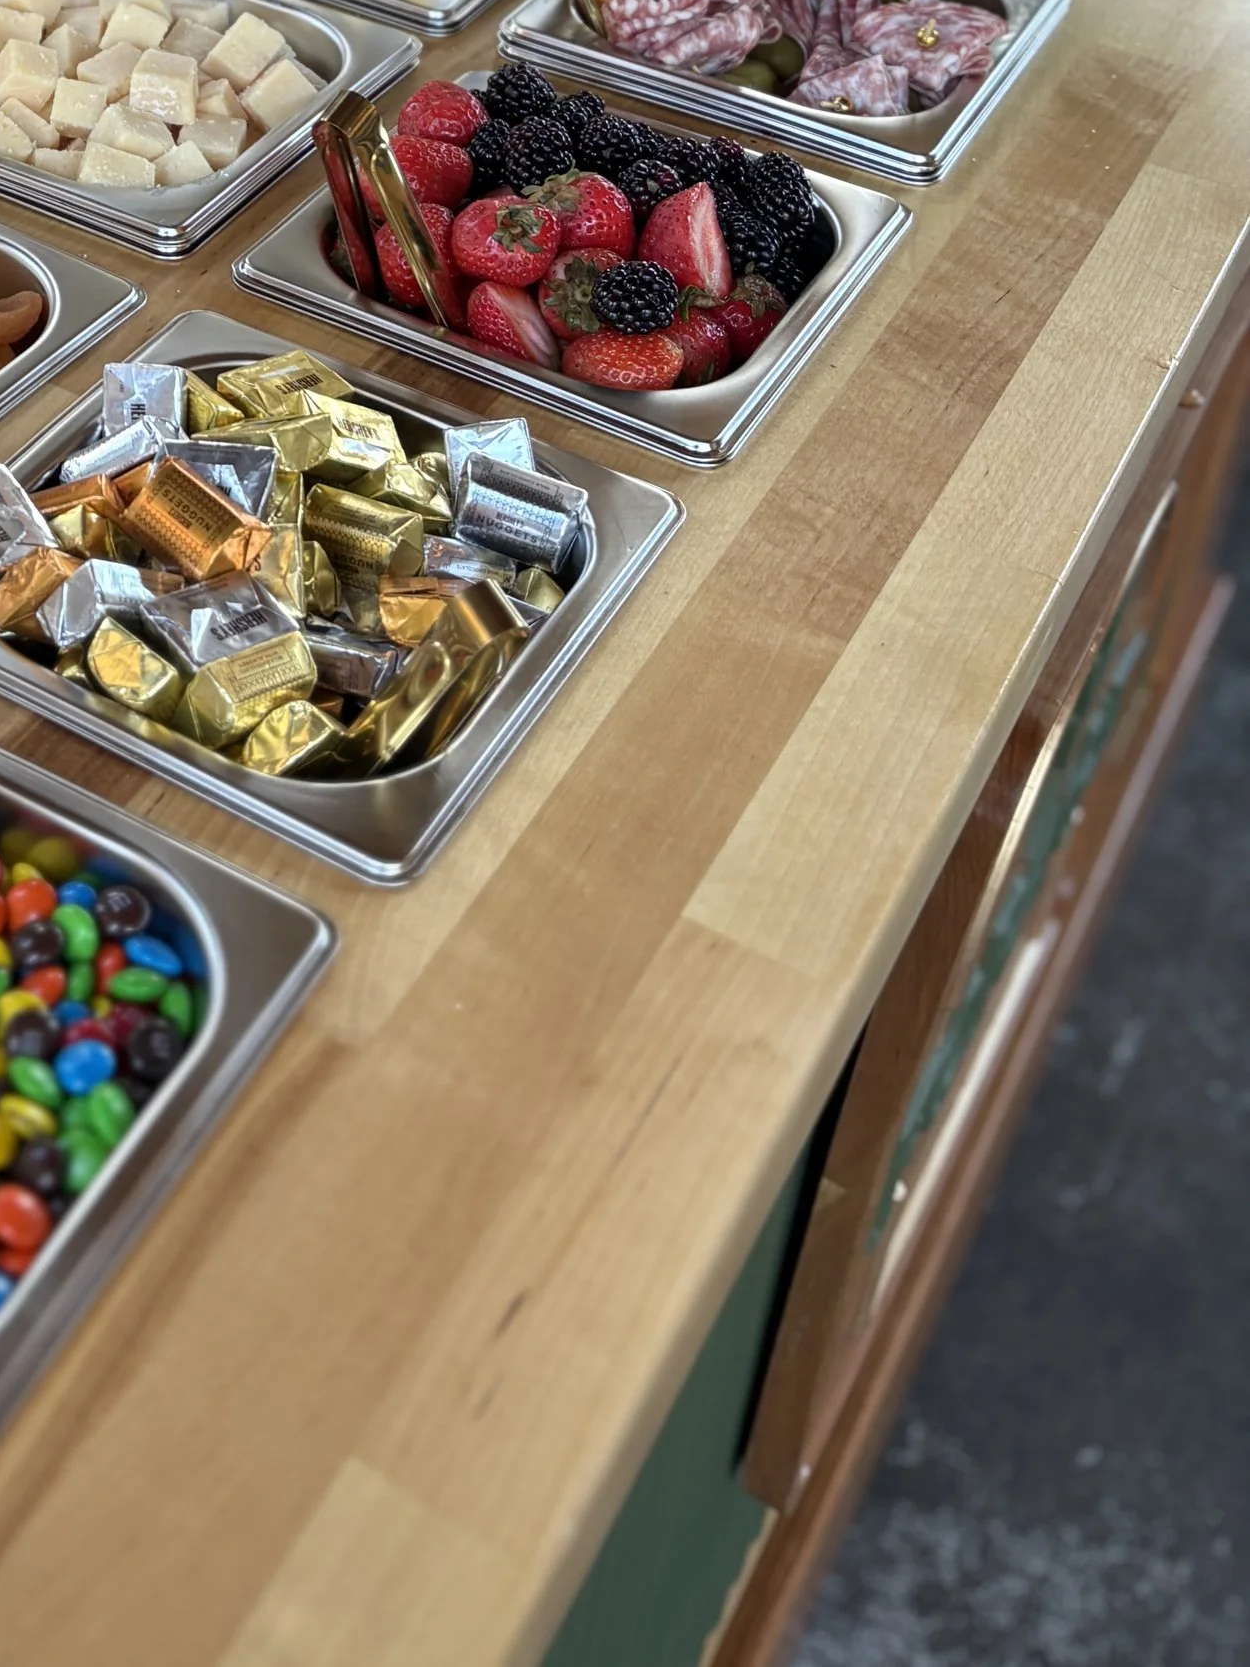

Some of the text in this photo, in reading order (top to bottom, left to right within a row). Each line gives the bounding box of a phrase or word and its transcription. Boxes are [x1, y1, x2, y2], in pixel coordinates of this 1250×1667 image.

[275, 373, 324, 395] HERSHEY'S
[161, 488, 212, 532] NUGGETS
[476, 515, 539, 544] NUGGETS
[210, 609, 268, 641] HERSHEY'S
